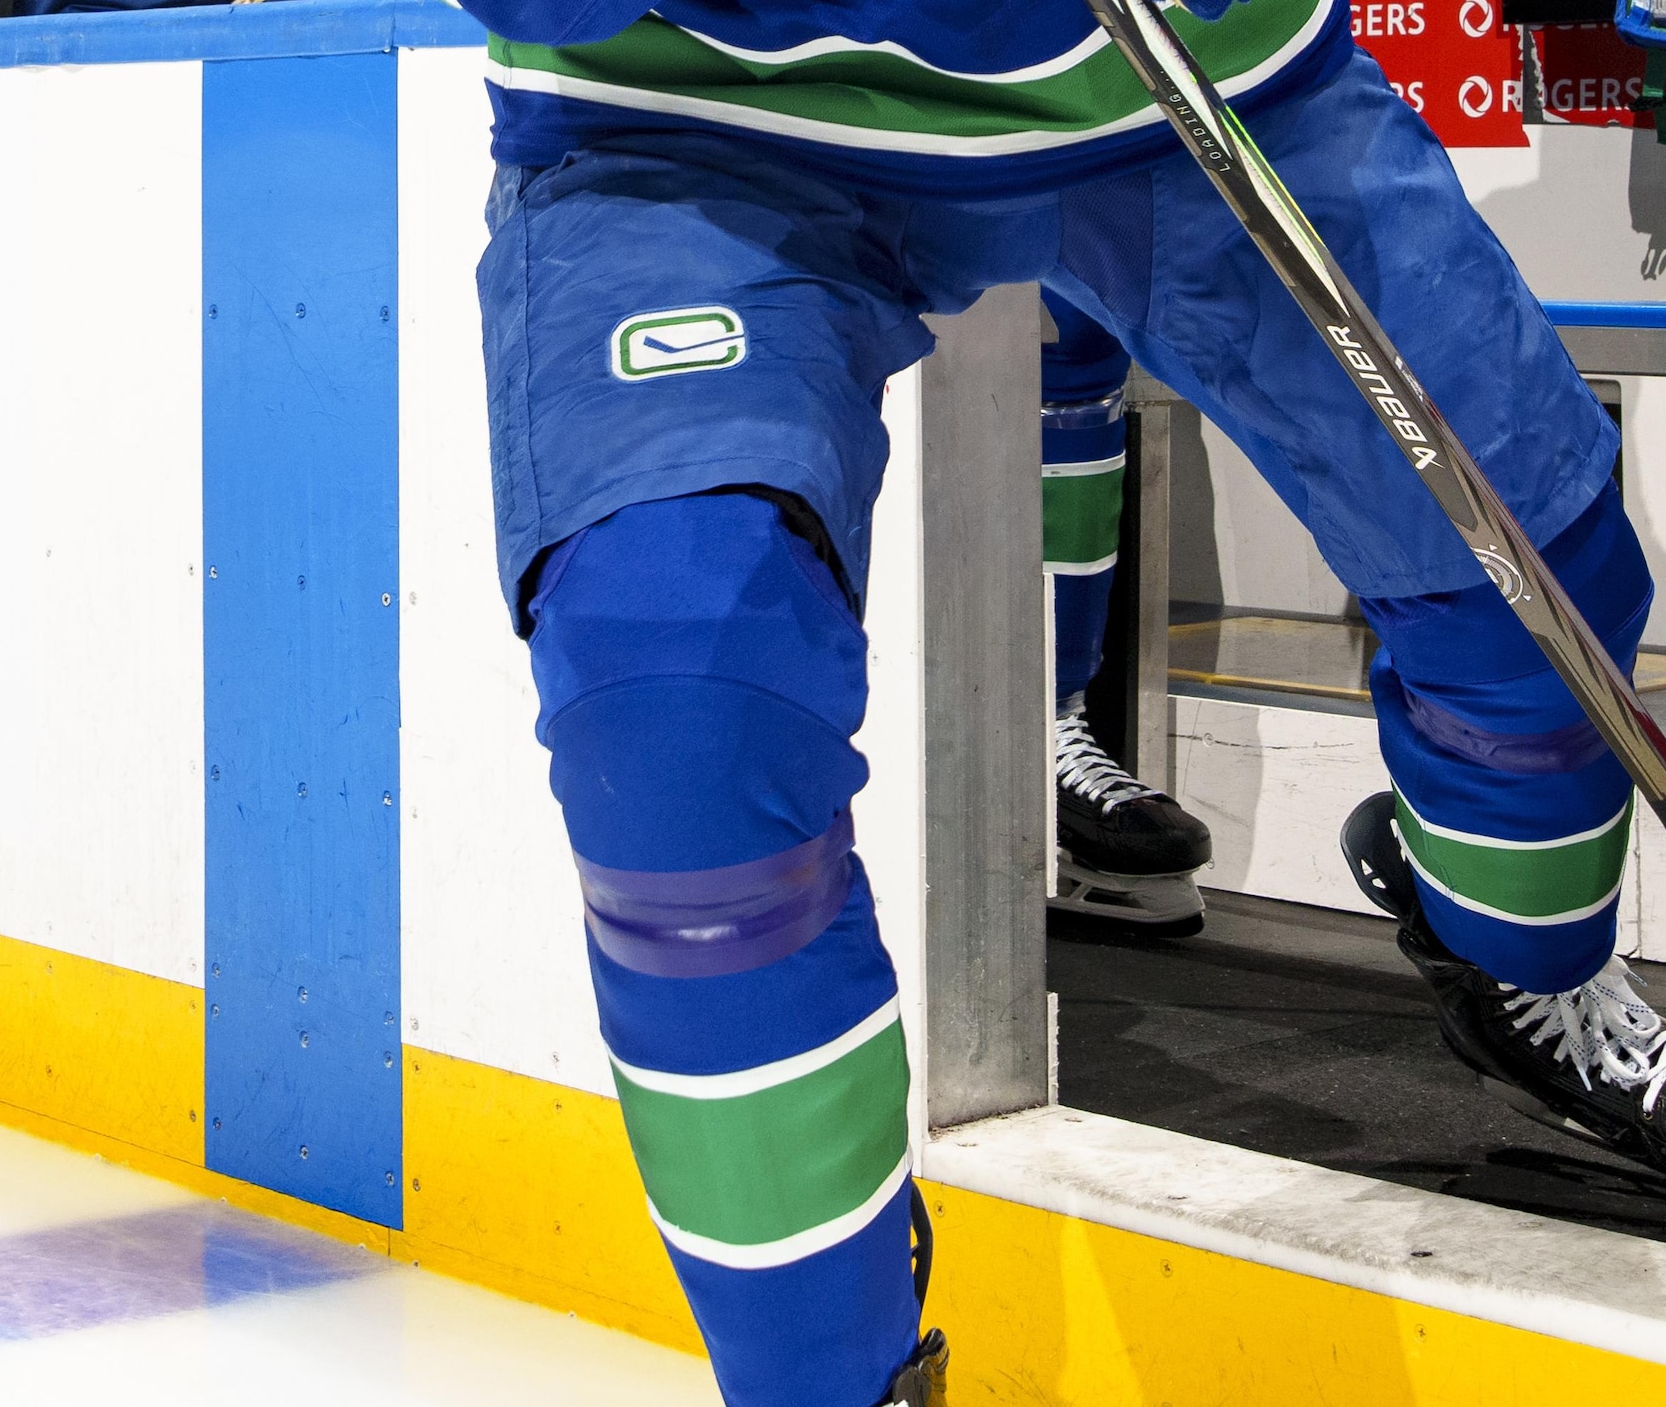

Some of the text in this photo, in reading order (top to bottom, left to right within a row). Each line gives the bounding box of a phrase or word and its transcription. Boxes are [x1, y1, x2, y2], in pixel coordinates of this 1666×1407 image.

[1350, 2, 1426, 36] GERS
[1160, 69, 1231, 172] LOADING...
[1326, 325, 1428, 443] BAUER
